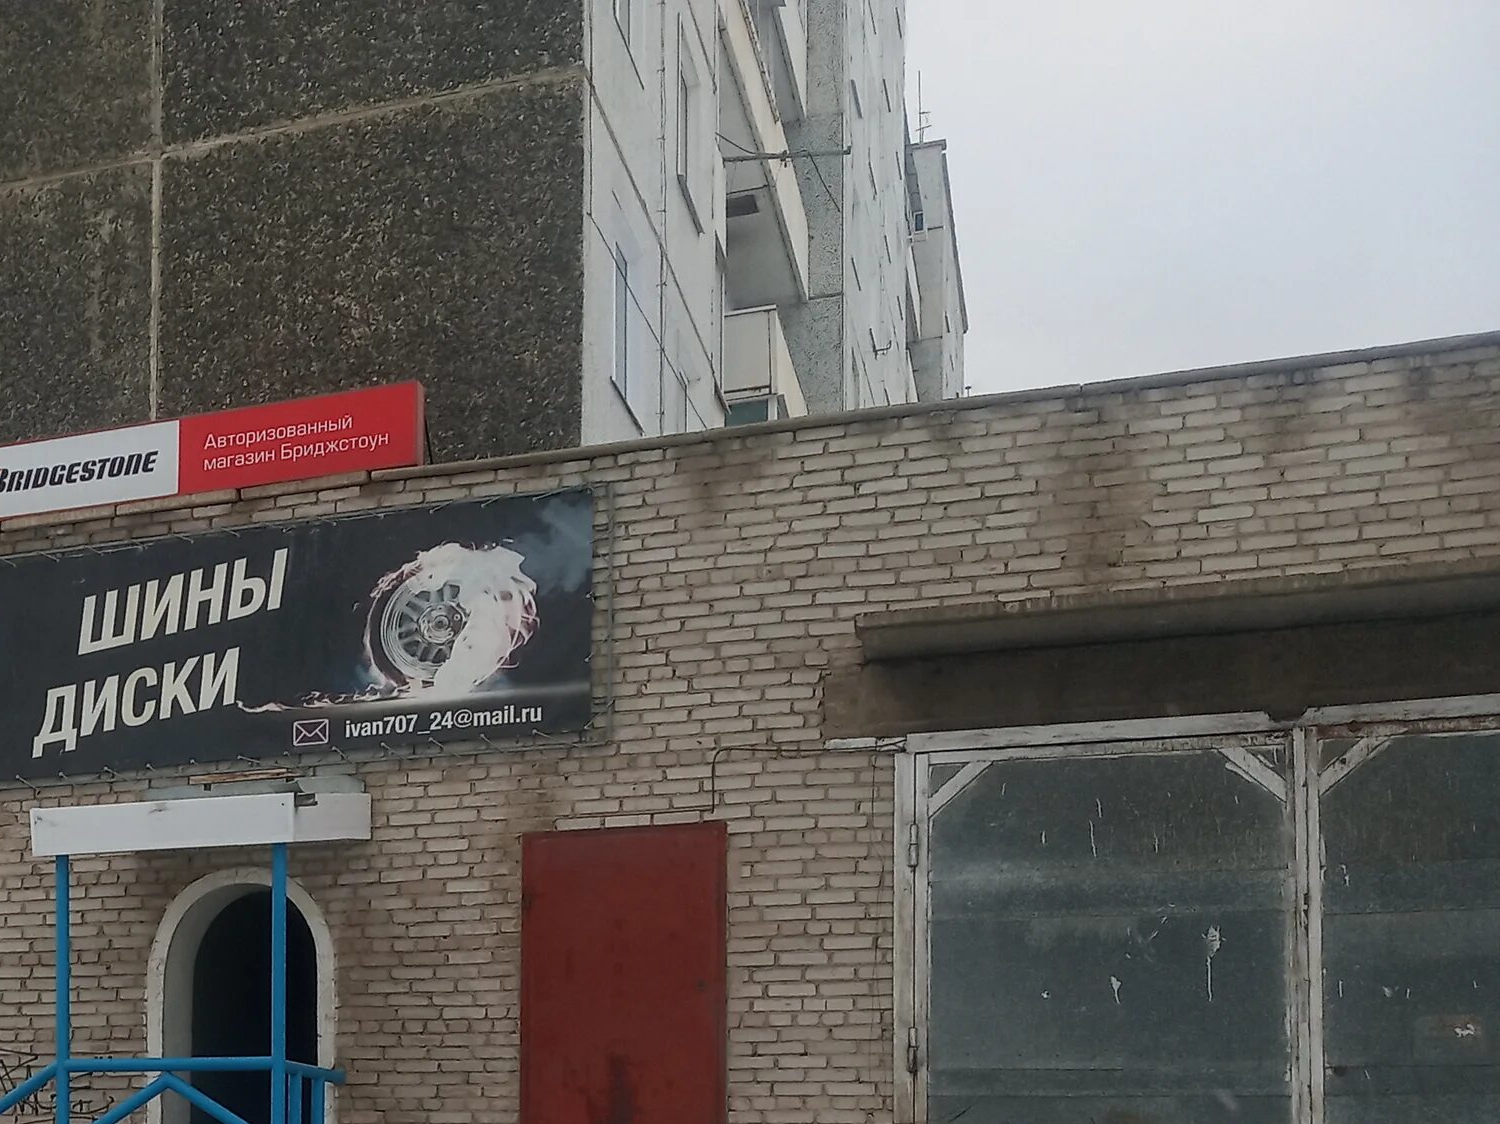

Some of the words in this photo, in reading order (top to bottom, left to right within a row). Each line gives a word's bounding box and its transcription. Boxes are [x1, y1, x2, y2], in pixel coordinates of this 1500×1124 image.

[204, 415, 353, 450] Авторизованный
[203, 449, 275, 471] магазин
[280, 433, 389, 462] Бриджстоун
[77, 547, 289, 655] ШИНЫ
[32, 648, 241, 758] ДИСКИ
[345, 705, 543, 738] ivan707_24@mail.ru
